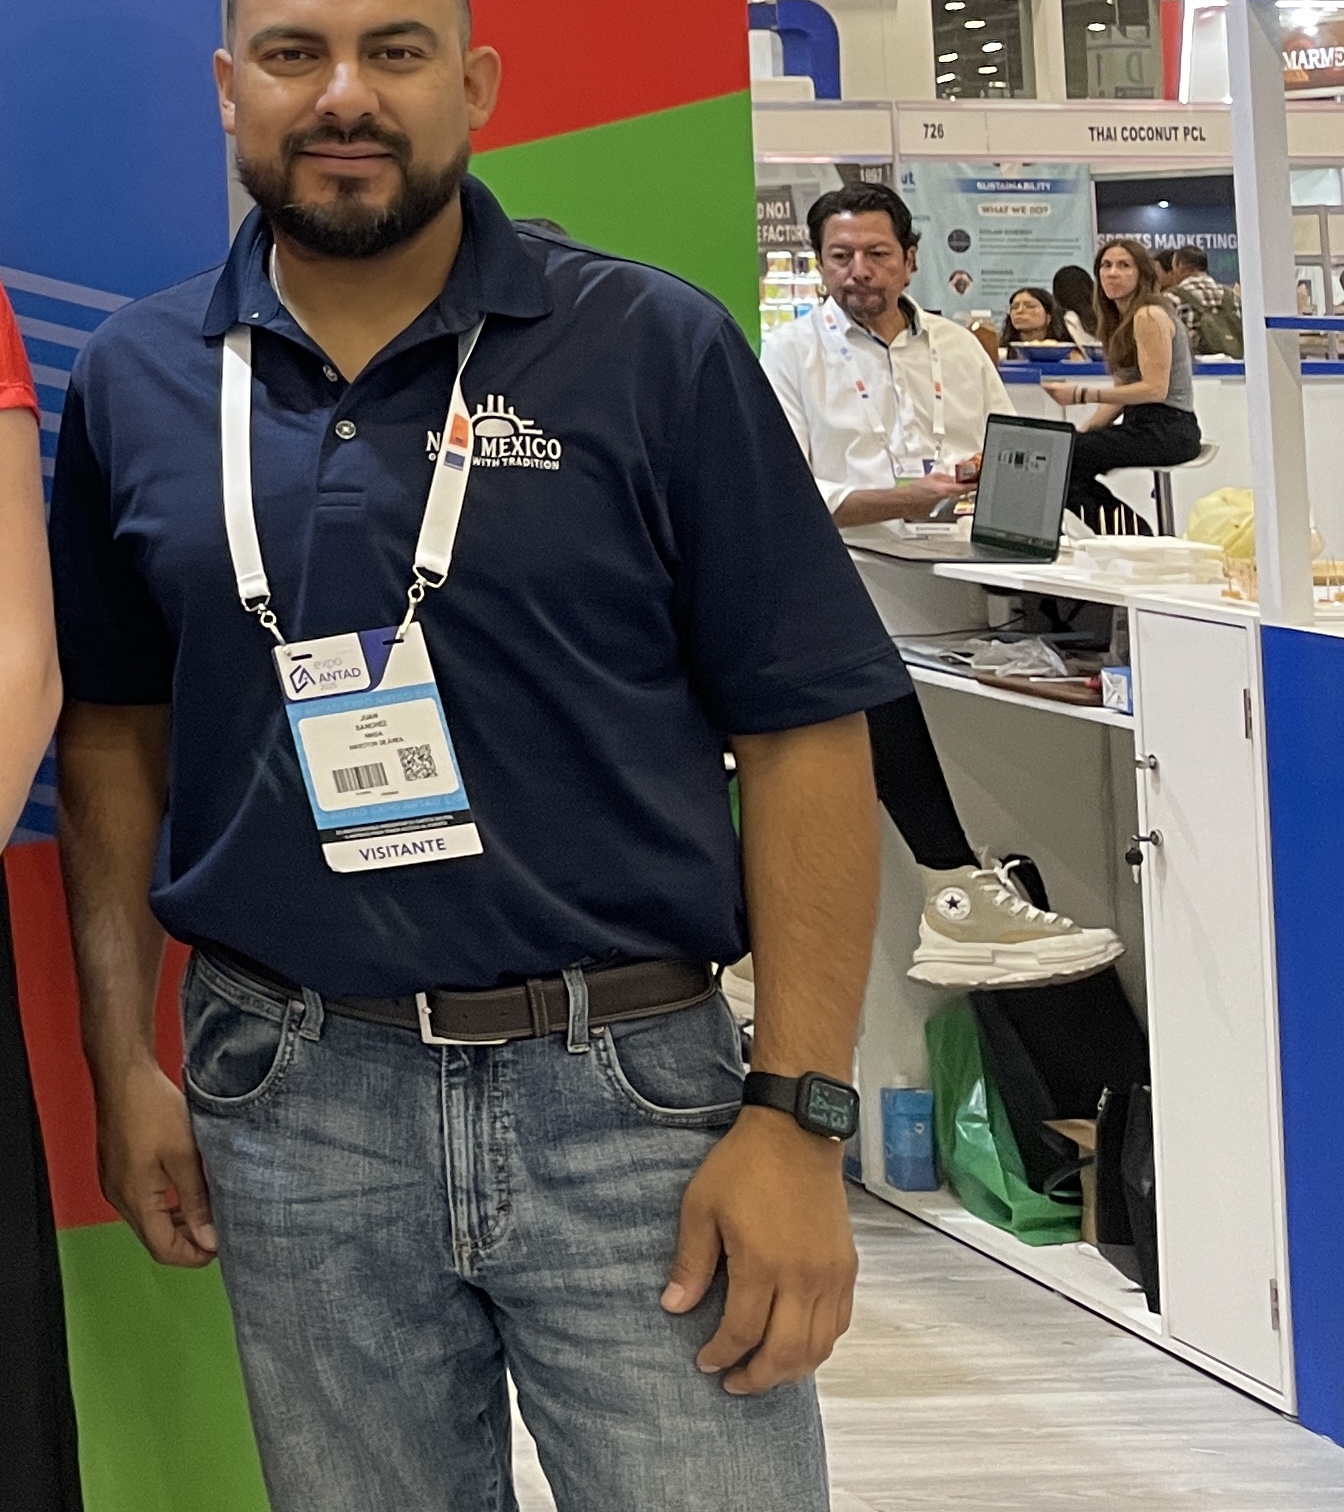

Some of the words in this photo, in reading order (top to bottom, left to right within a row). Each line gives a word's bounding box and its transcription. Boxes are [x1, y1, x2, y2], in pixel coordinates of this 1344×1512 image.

[1088, 125, 1117, 141] THAI
[1120, 126, 1179, 142] COCONUT
[1183, 126, 1206, 141] PCL
[976, 181, 1052, 192] SUSTAINABILITY
[1154, 233, 1238, 250] MARKETING
[480, 436, 562, 460] MEXICO
[472, 457, 500, 468] WITH
[501, 458, 560, 471] TRADITION
[319, 667, 362, 684] ANTAD
[359, 837, 447, 862] VISITANTE
